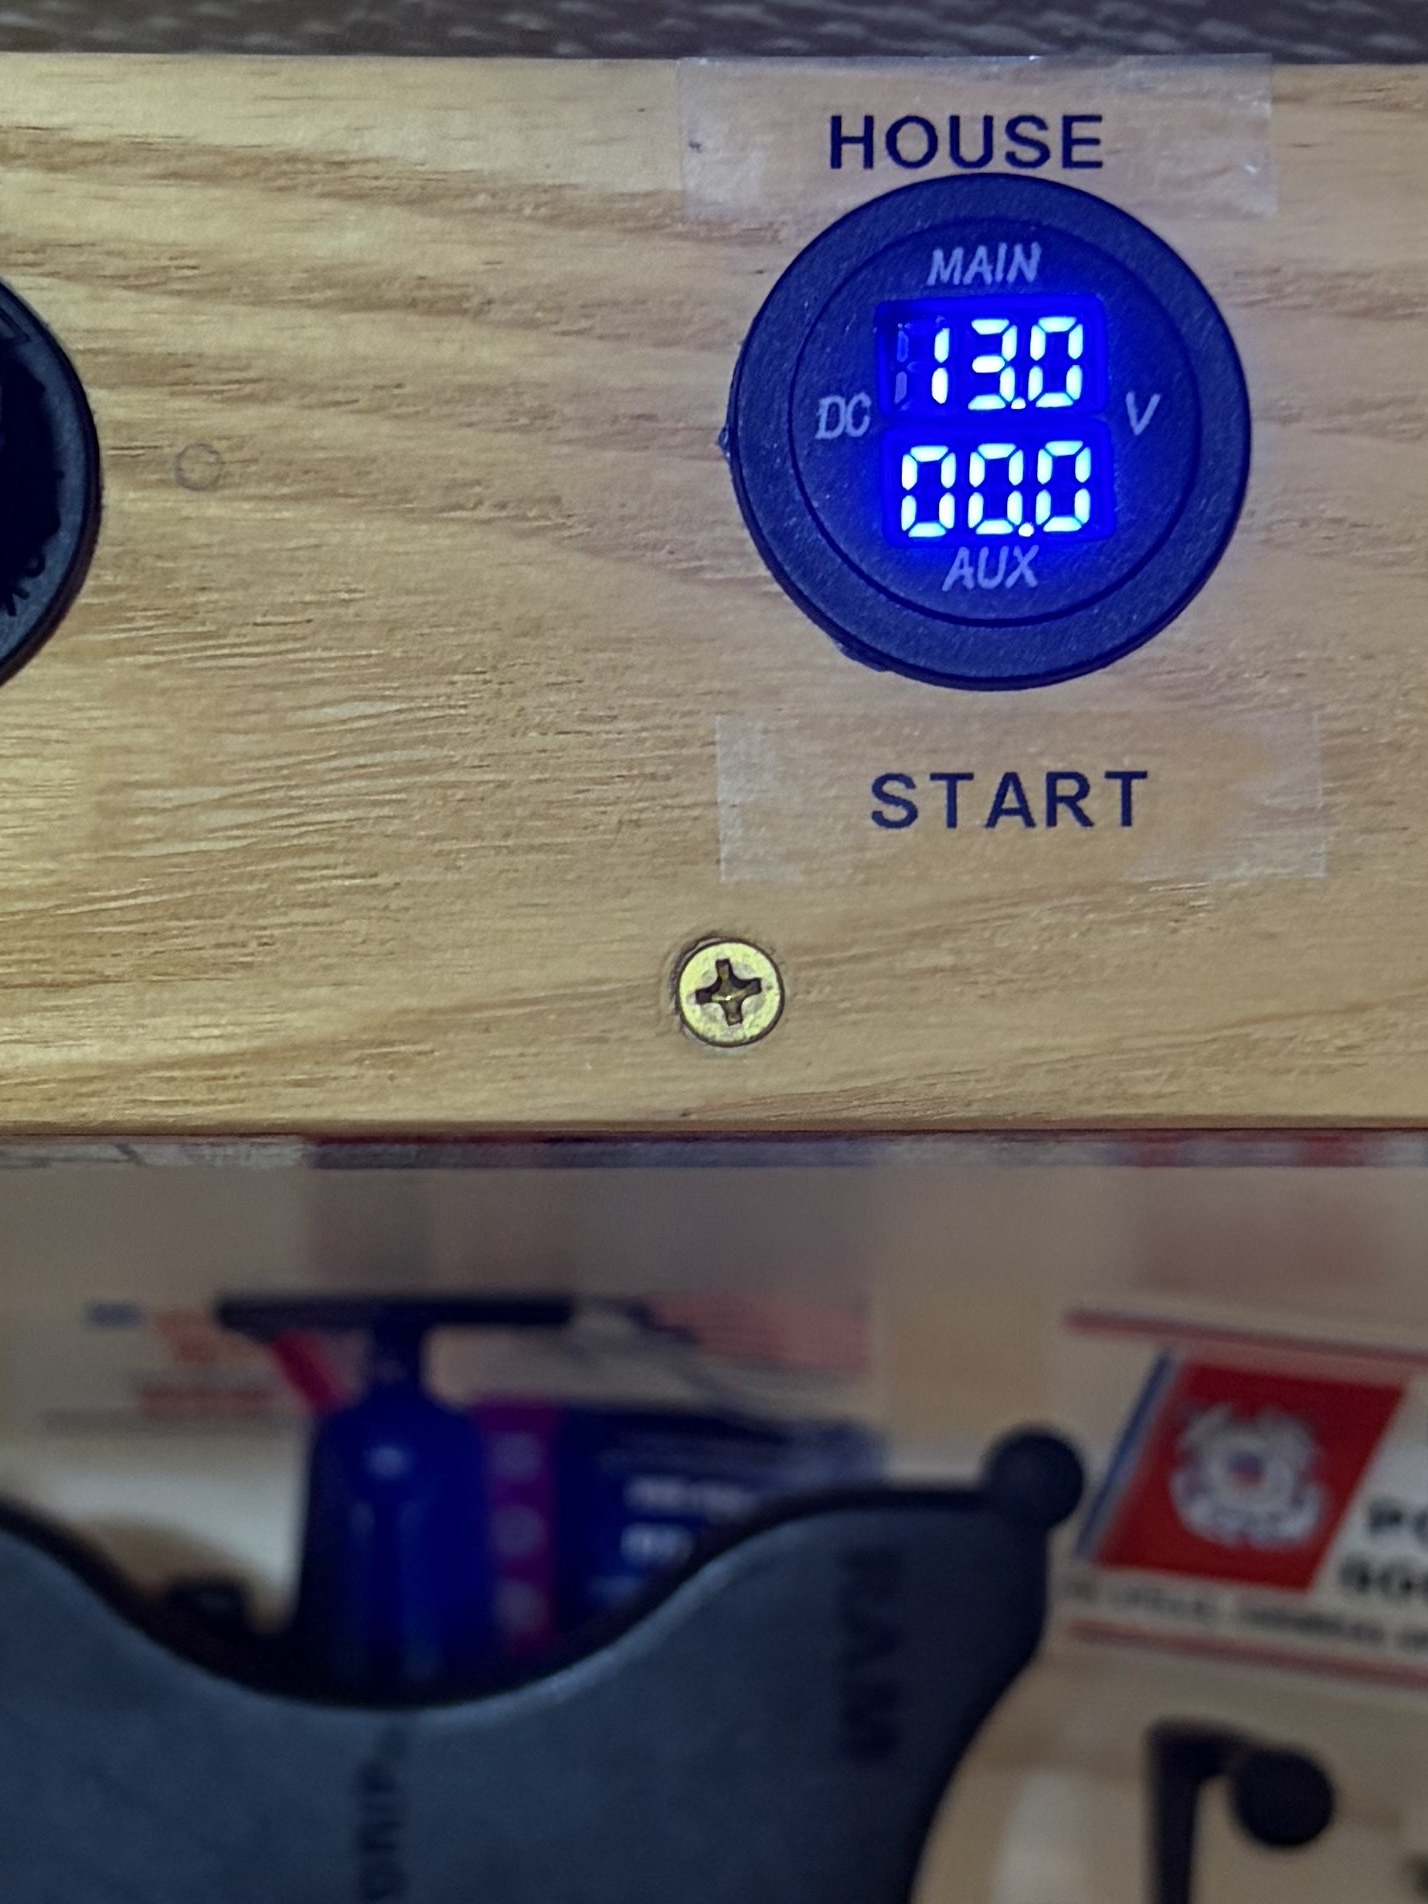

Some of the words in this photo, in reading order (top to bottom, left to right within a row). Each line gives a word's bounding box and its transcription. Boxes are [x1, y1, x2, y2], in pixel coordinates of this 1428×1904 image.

[828, 113, 1105, 171] HOUSE
[926, 242, 1042, 286] MAIN
[930, 315, 1084, 411] 13.0
[815, 392, 872, 440] DC
[1124, 391, 1162, 437] V
[900, 439, 1092, 539] 00.0
[941, 544, 1040, 592] AUX
[869, 770, 1149, 829] START
[834, 1544, 905, 1764] RAM
